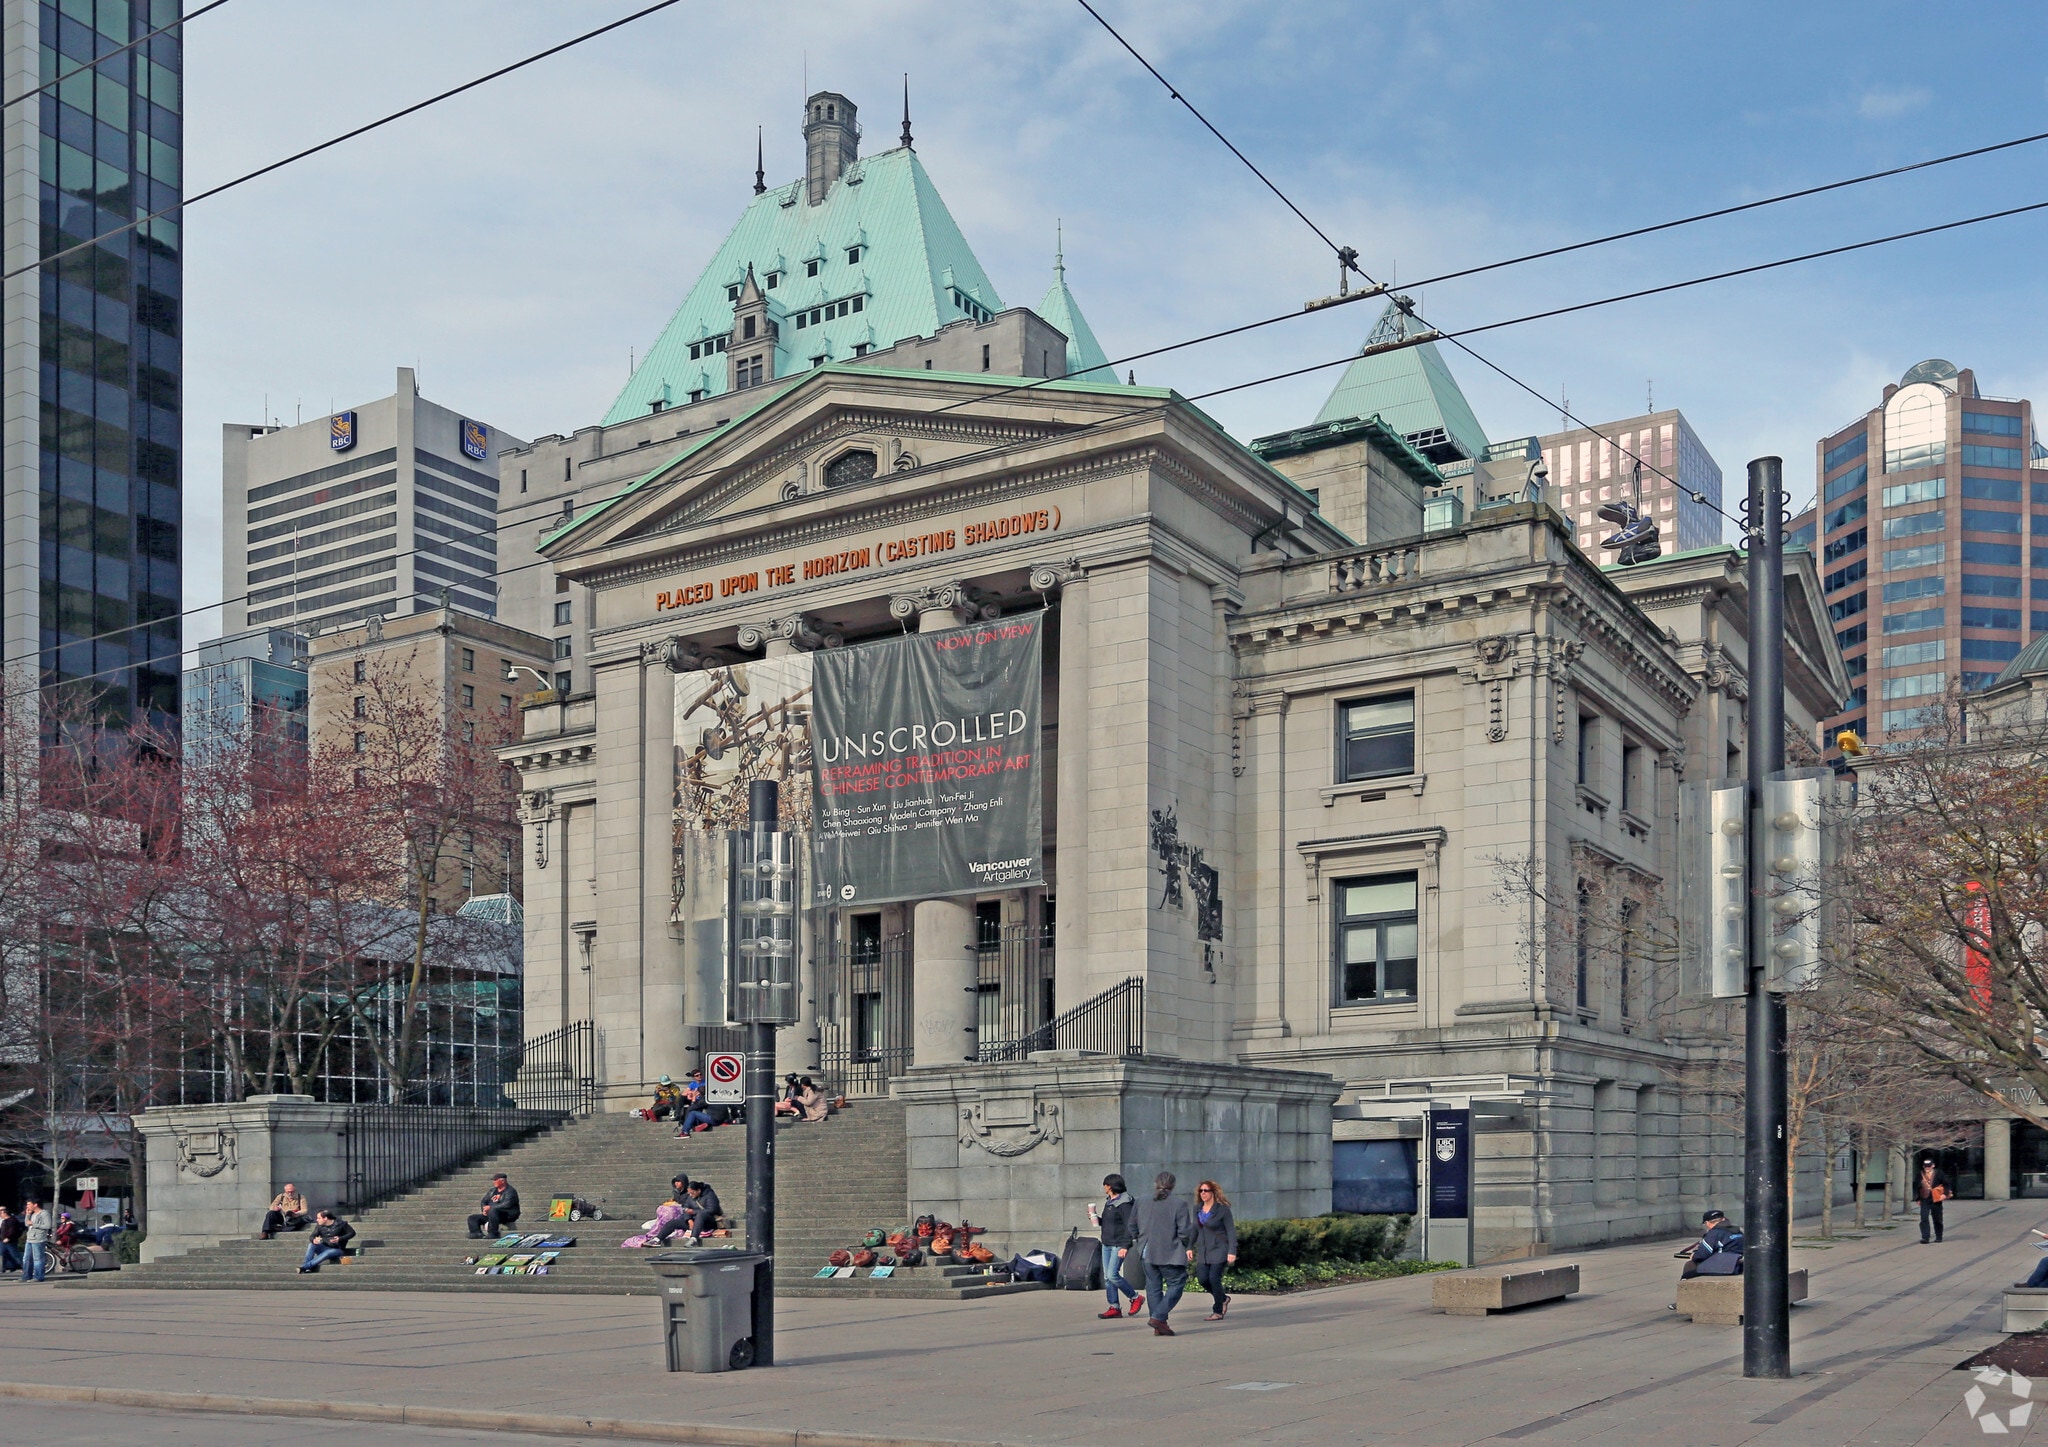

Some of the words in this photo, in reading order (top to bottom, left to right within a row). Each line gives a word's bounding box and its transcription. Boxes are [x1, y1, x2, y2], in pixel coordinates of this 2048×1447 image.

[332, 435, 350, 448] RBC
[467, 443, 486, 458] RBC
[656, 582, 714, 612] PLACED
[720, 572, 759, 598] UPON
[765, 564, 795, 587] THE
[803, 548, 870, 581] HORIZON
[936, 634, 972, 652] NOW
[976, 629, 997, 645] ON
[1000, 623, 1034, 639] VIEW
[823, 709, 1027, 762] UNSCROLLED
[821, 777, 880, 796] CHINESE
[885, 760, 1003, 788] CONTEMPORARY
[1004, 754, 1031, 771] ART
[822, 758, 902, 781] REFRAMING
[905, 748, 982, 769] TRADITION
[986, 744, 1002, 759] IN
[822, 808, 831, 817] Xu
[833, 808, 850, 818] Bing
[857, 805, 871, 814] Sun
[872, 803, 887, 812] Xun
[893, 801, 904, 809] Liu
[904, 797, 933, 809] Jianhua
[940, 792, 967, 803] Yun-Fei
[968, 791, 975, 800] Ji
[822, 820, 842, 828] Chen
[919, 806, 957, 818] Company
[963, 801, 988, 812] Zhang
[990, 797, 1004, 807] Enli
[867, 826, 882, 835] Qiu
[883, 823, 908, 833] Shihua
[914, 818, 943, 830] Jennifer
[945, 816, 964, 825] Wen
[965, 814, 979, 823] Ma
[968, 858, 1033, 873] Vancouver
[983, 869, 1032, 883] Artgallery
